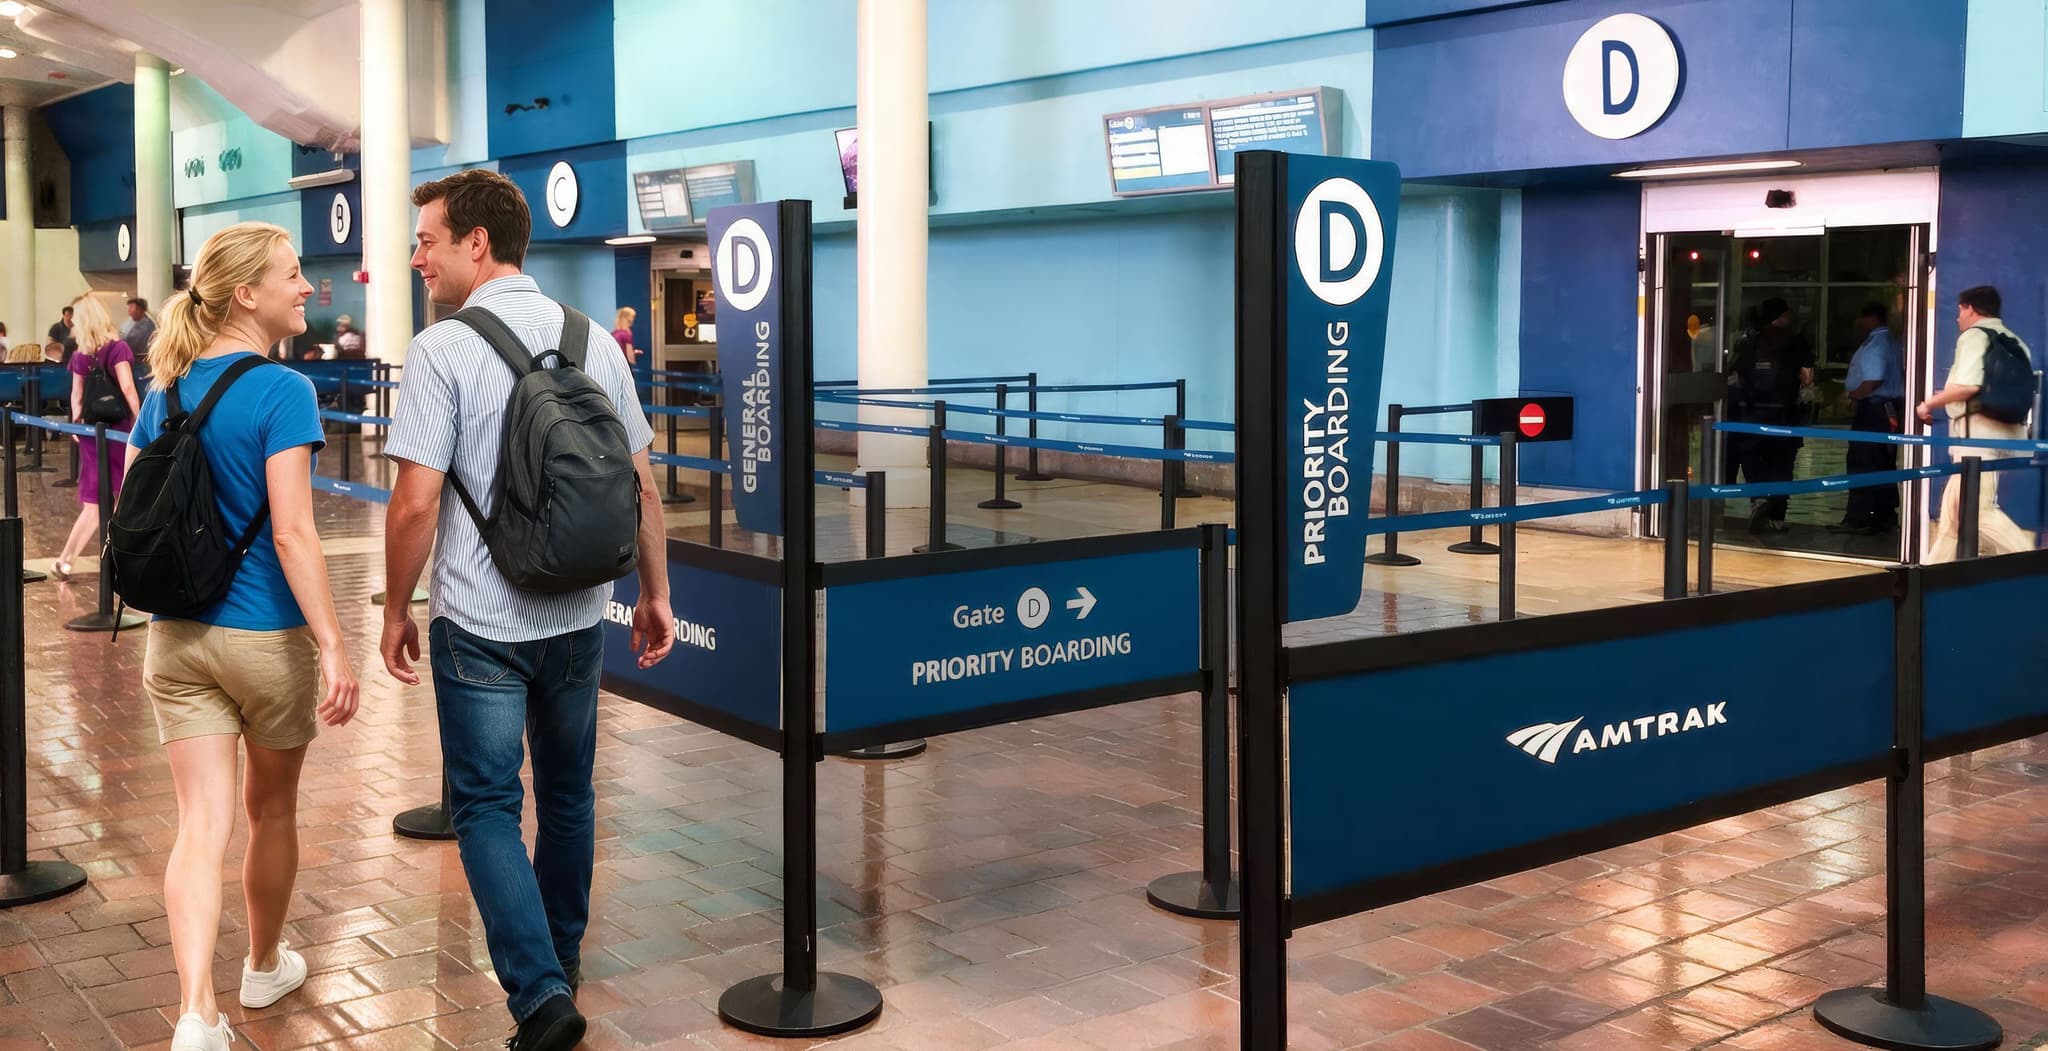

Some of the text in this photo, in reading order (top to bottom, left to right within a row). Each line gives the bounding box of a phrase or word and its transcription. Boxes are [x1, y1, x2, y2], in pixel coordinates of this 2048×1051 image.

[1602, 40, 1639, 115] D
[553, 176, 567, 211] C
[731, 236, 761, 294] D
[1319, 199, 1368, 283] D
[755, 321, 771, 462] BOARDING
[1327, 321, 1350, 517] BOARDING
[742, 373, 757, 493] GENERAL
[1303, 398, 1326, 565] PRIORITY
[673, 617, 716, 650] RDING
[953, 598, 1041, 629] Gate D
[912, 632, 1132, 686] PRIORITY BOARDING
[1573, 701, 1727, 754] AMTRAK
